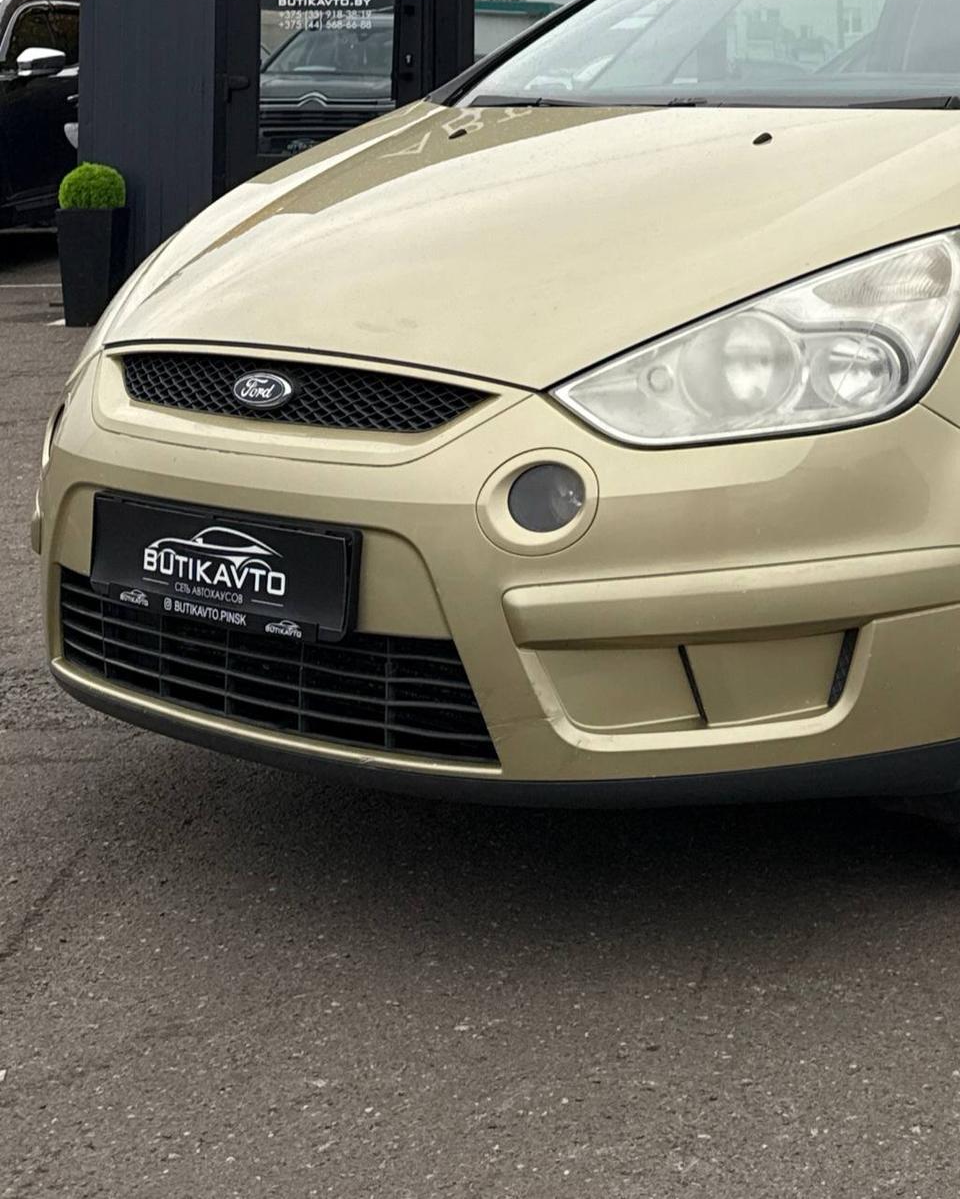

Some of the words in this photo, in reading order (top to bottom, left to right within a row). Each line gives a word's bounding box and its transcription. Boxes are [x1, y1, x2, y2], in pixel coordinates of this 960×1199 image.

[240, 378, 275, 398] Ford
[143, 548, 286, 596] BUTIKAVTO
[174, 582, 191, 595] СЕТЬ
[191, 584, 243, 604] АВТОХАУСОВ
[174, 599, 247, 626] BUTIKAVTO.PINSK
